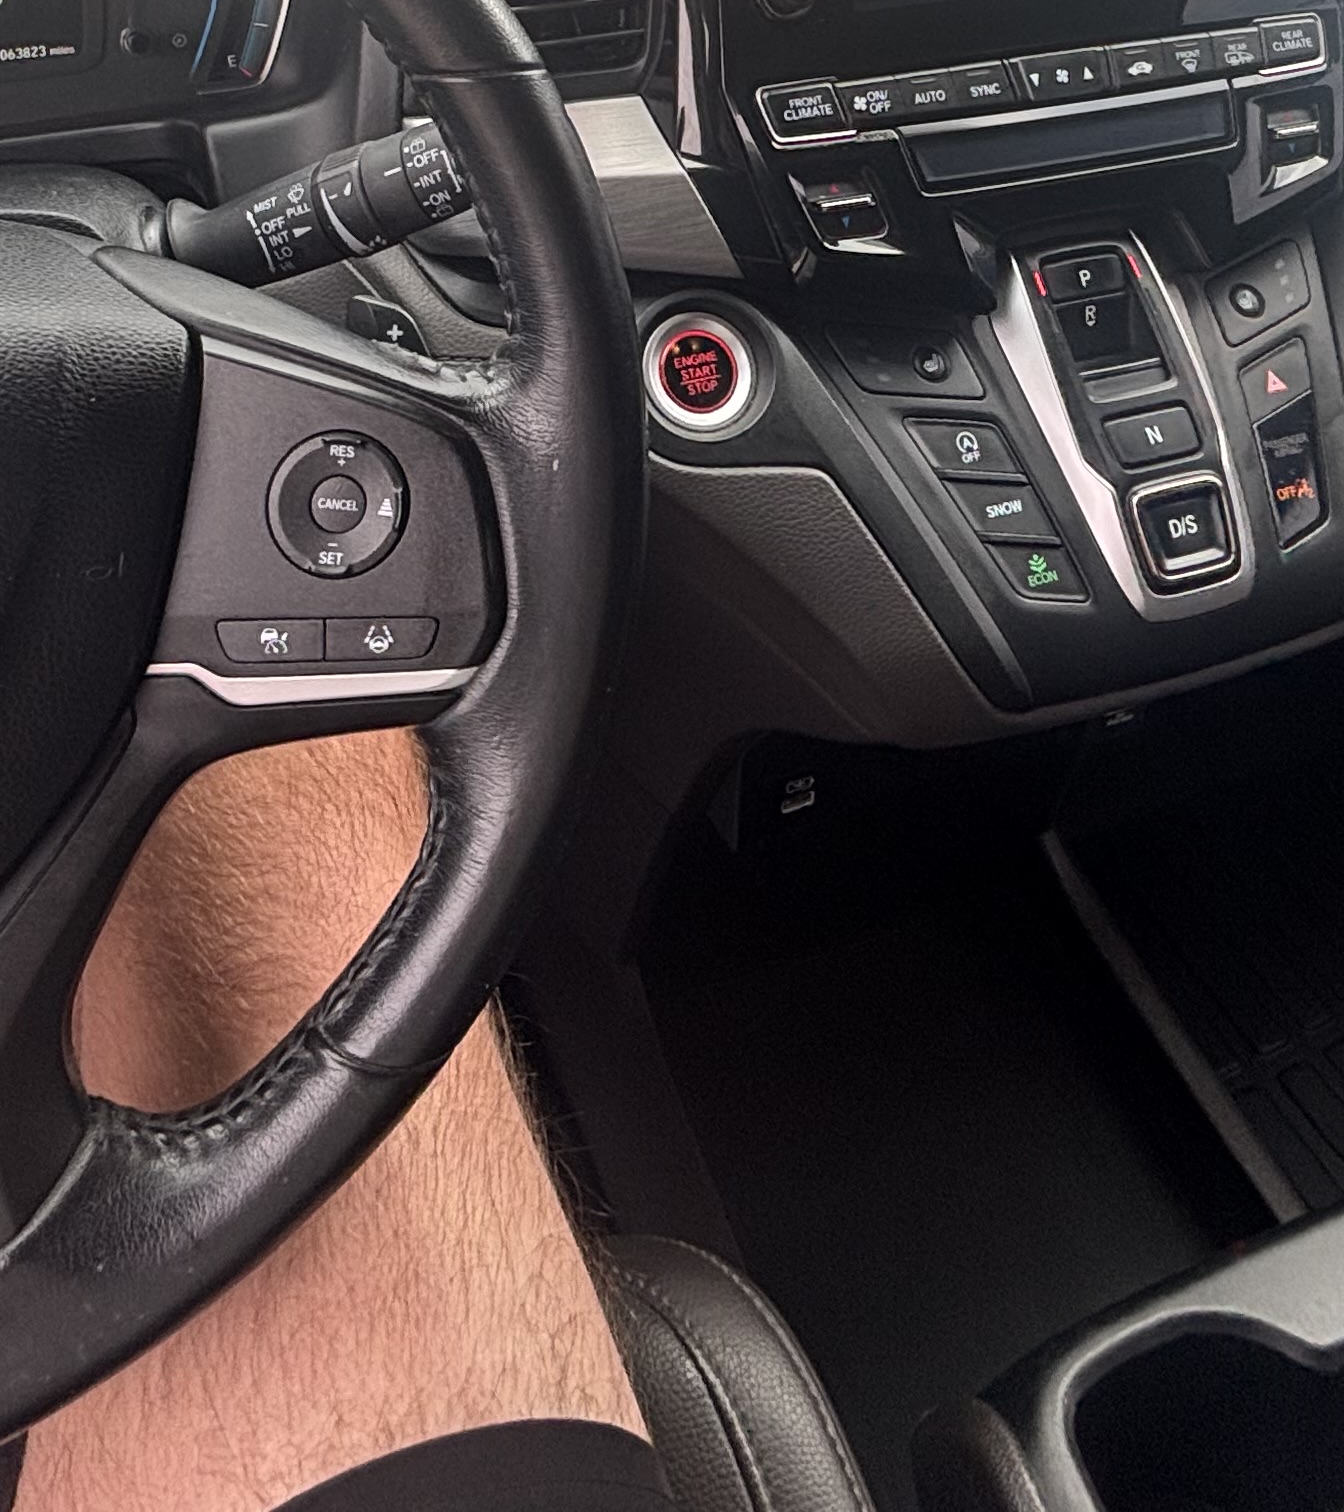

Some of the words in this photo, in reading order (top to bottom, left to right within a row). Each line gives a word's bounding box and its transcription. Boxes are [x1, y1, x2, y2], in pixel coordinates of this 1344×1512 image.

[1281, 29, 1303, 40] REAR
[1272, 37, 1313, 52] CLIMATE
[0, 45, 47, 62] 063823
[227, 54, 238, 68] E
[1175, 49, 1201, 61] FRONT
[867, 90, 888, 101] ON/
[914, 90, 946, 105] AUTO
[969, 83, 1001, 98] SYNC
[789, 95, 823, 109] FRONT
[869, 101, 892, 114] OFF
[783, 104, 833, 122] CLIMATE
[413, 148, 439, 168] OFF
[419, 173, 443, 189] INT
[254, 197, 278, 214] MIST
[429, 190, 452, 206] ON
[286, 204, 311, 219] PULL
[261, 217, 286, 236] OFF
[268, 231, 289, 246] INT
[274, 247, 294, 261] LO
[1078, 269, 1091, 288] P
[1085, 304, 1096, 323] R
[674, 350, 718, 368] ENGINE
[680, 364, 719, 381] START
[687, 379, 719, 396] STOP
[1144, 426, 1164, 445] N
[329, 444, 355, 458] RES
[961, 452, 981, 463] OFF
[1277, 485, 1296, 501] OFF
[318, 498, 359, 511] CANCEL
[986, 499, 1023, 518] SNOW
[1168, 514, 1198, 539] D/S
[318, 551, 344, 566] SET
[1028, 570, 1059, 587] ECON
